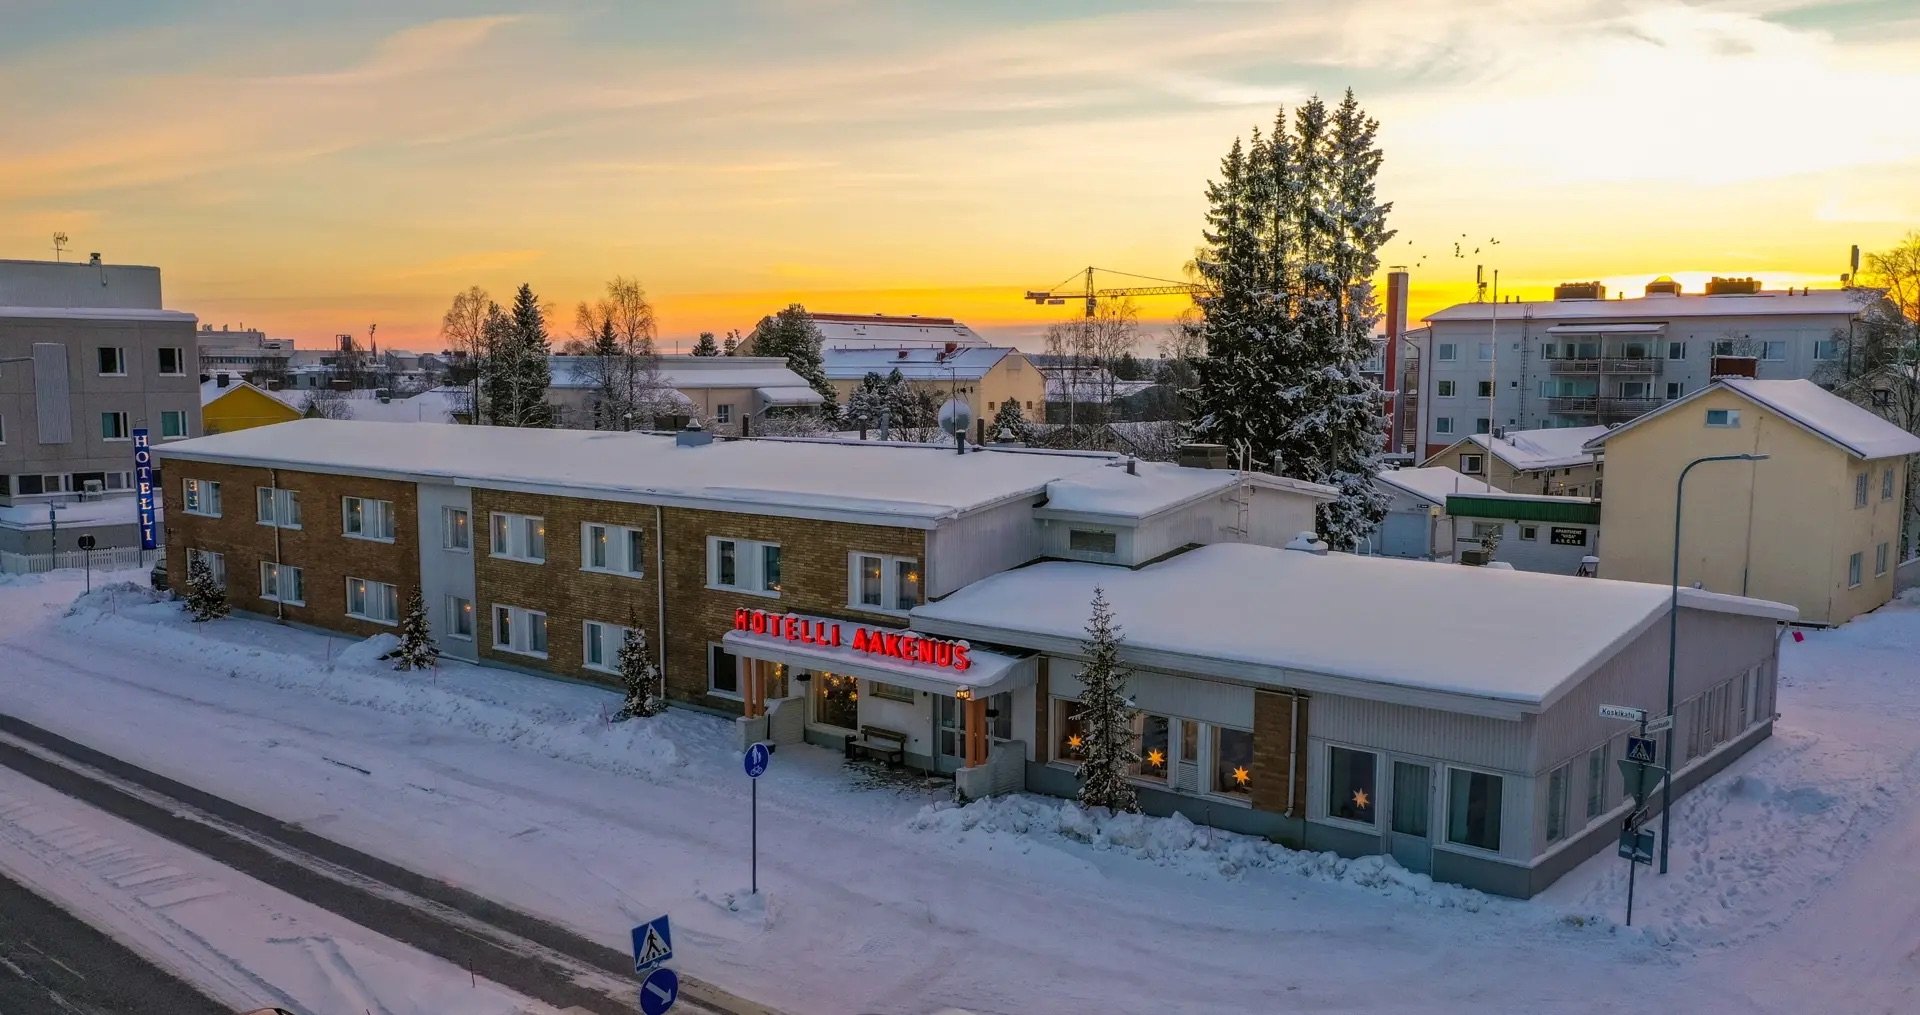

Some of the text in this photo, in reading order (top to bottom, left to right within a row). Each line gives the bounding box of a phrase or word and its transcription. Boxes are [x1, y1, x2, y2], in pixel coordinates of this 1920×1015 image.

[135, 435, 153, 541] HOTELLI
[735, 608, 972, 671] HOTELLI AAKENUS
[1602, 708, 1635, 718] Koskikatu
